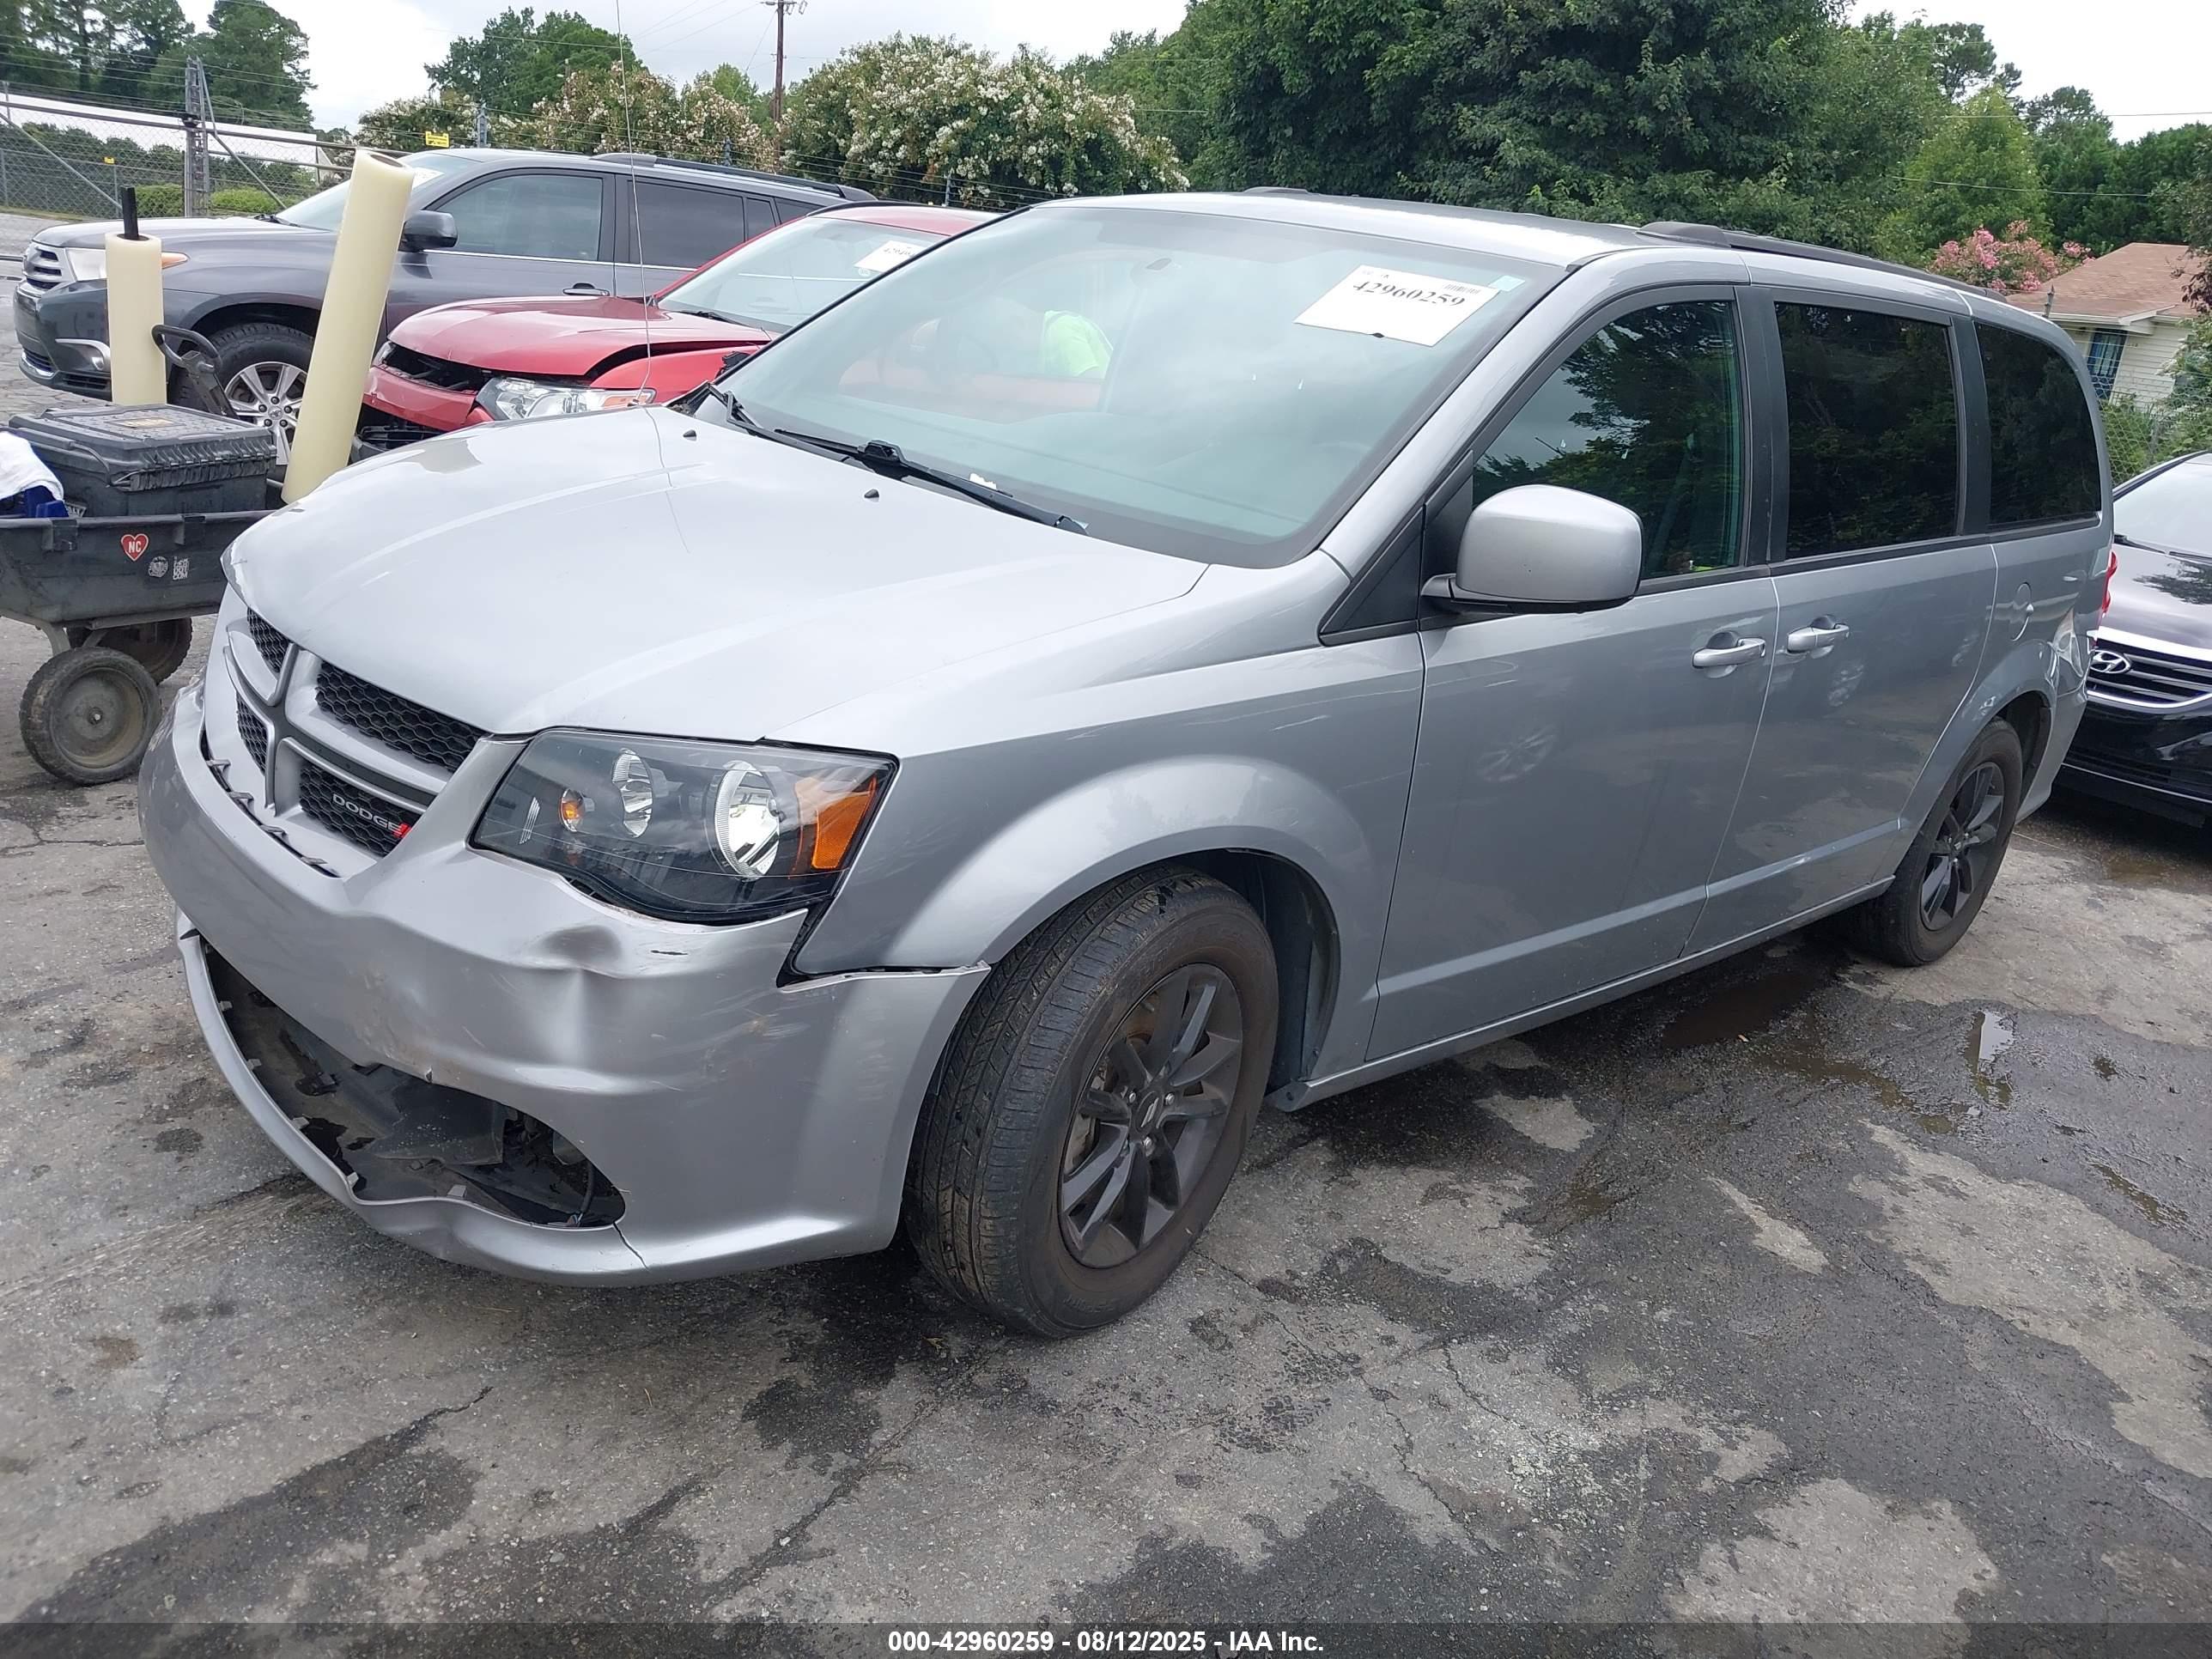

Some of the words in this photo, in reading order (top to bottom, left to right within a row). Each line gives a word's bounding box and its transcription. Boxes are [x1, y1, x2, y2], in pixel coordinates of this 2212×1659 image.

[1352, 281, 1466, 307] 42960259
[128, 541, 142, 553] NC
[333, 793, 402, 835] DODGE
